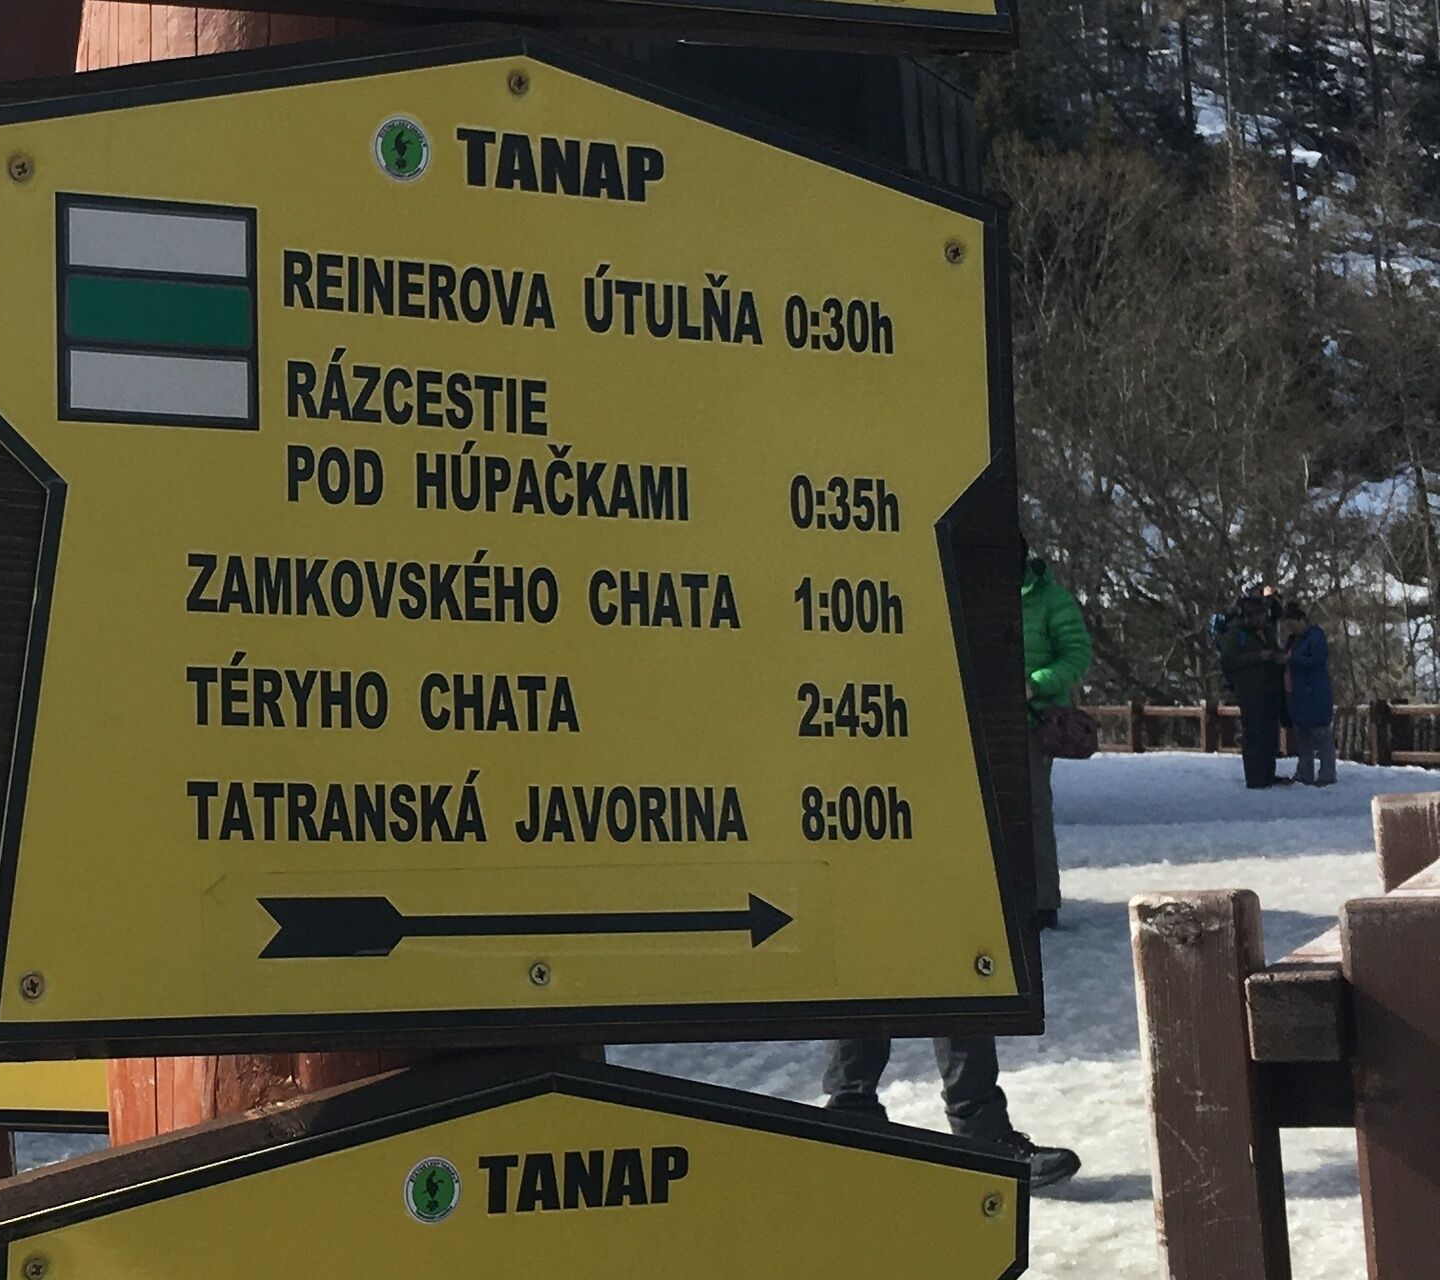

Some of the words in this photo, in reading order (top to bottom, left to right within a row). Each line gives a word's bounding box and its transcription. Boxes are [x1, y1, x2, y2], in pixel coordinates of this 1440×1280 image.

[457, 128, 664, 202] TANAP
[284, 250, 555, 329] REINEROVA
[585, 264, 763, 344] ÚTULŇA
[785, 295, 893, 354] 0:30h
[288, 348, 547, 436] RÁZCESTIE
[288, 445, 383, 505] POD
[416, 444, 688, 521] HÚPAČKAMI
[791, 475, 899, 532] 0:35h
[187, 550, 558, 623] ZAMKOVSKÉHO
[589, 570, 740, 628] CHATA
[795, 577, 903, 634] 1:00h
[187, 652, 387, 729] TÉRYHO
[421, 673, 579, 732] CHATA
[798, 683, 908, 737] 2:45h
[187, 770, 487, 842] TATRANSKÁ
[516, 786, 748, 842] JAVORINA
[802, 786, 912, 841] 8:00h
[479, 1147, 688, 1214] TANAP
